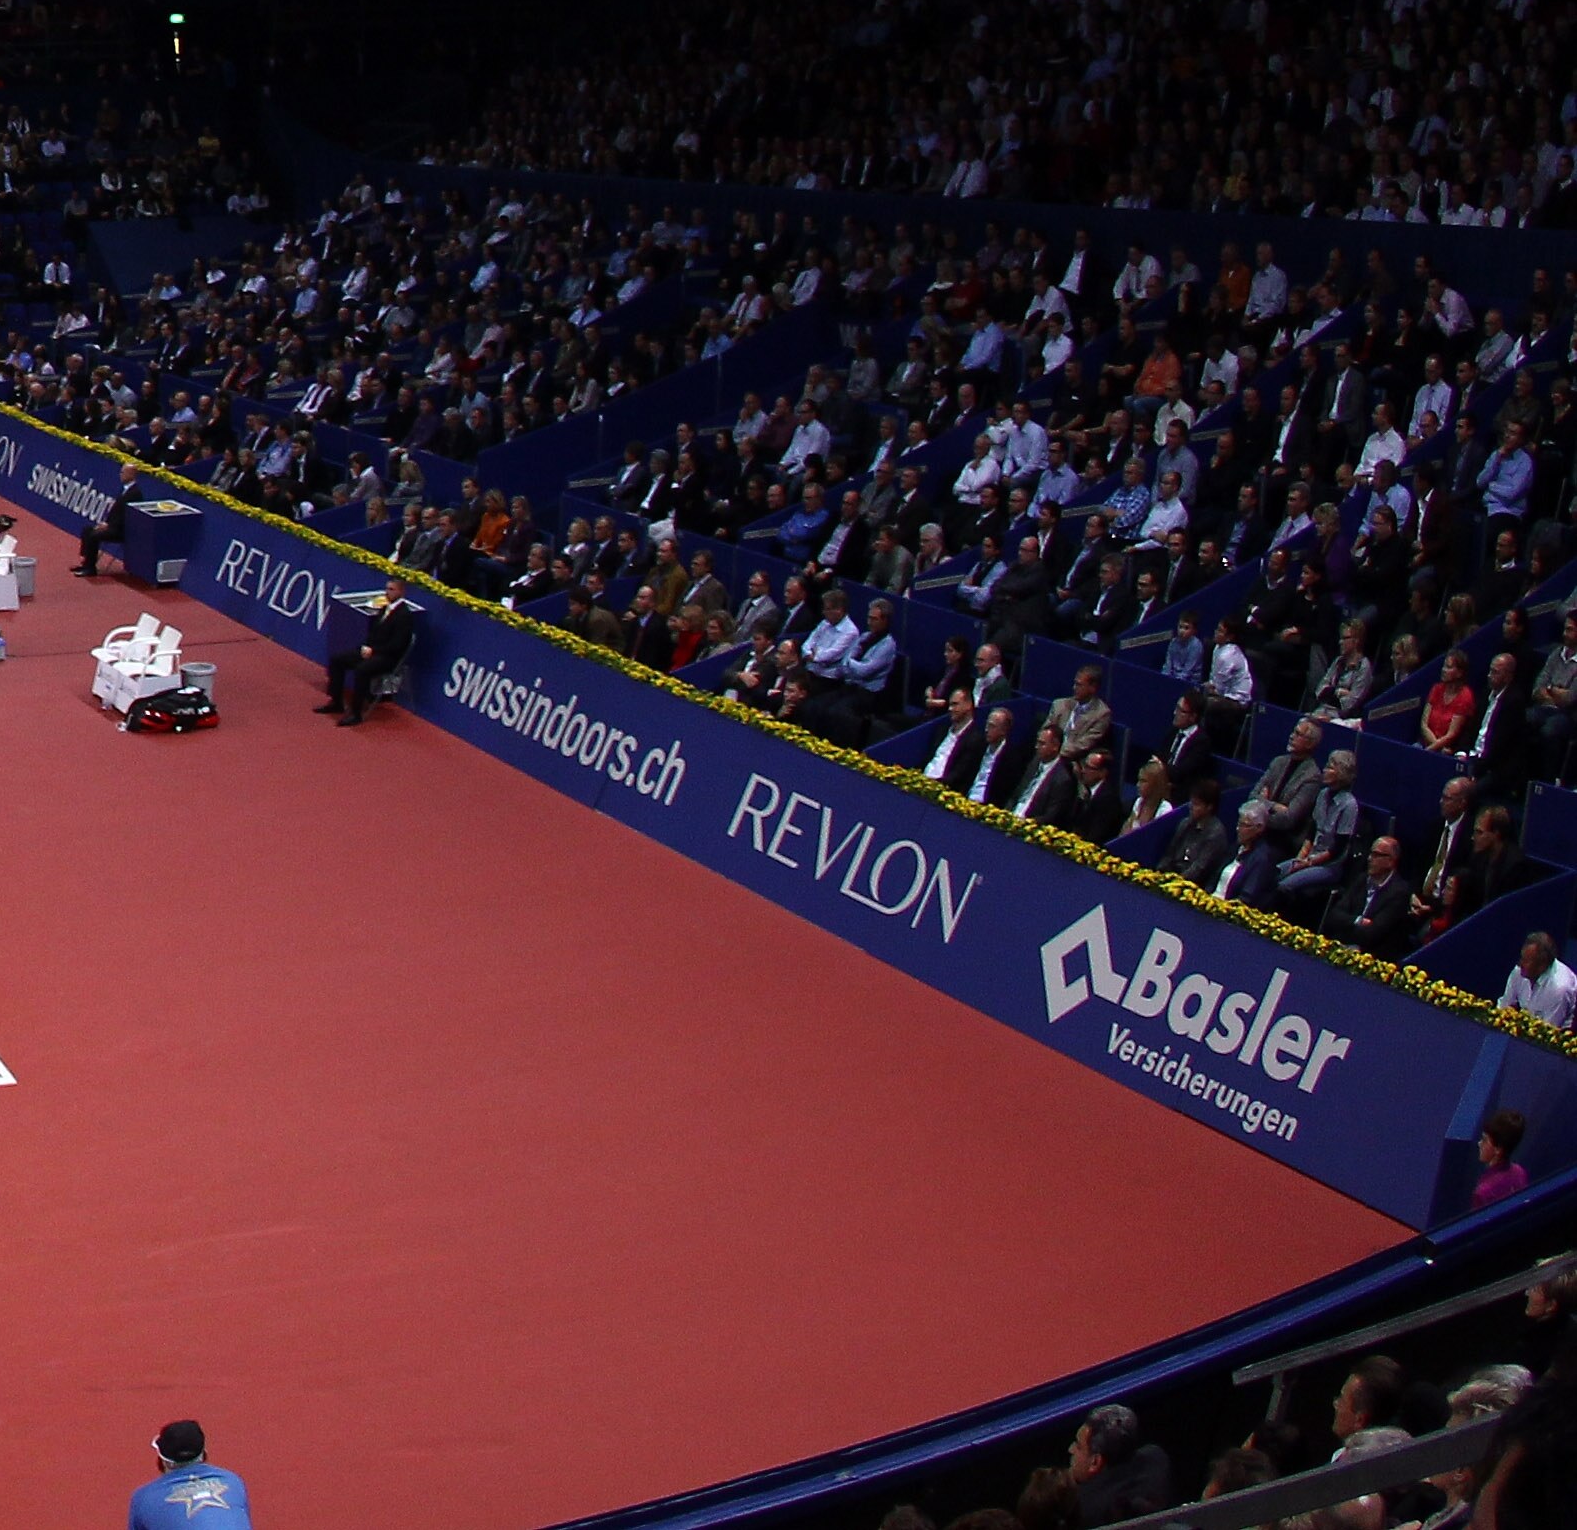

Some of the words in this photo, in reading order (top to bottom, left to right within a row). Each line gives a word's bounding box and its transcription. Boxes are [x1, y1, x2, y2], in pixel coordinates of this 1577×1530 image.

[216, 539, 332, 632] REVLON
[444, 656, 686, 806] swissindoors.ch
[727, 772, 973, 944] REVLON
[1107, 1023, 1298, 1143] Versicherungen
[1122, 927, 1353, 1095] Basler
